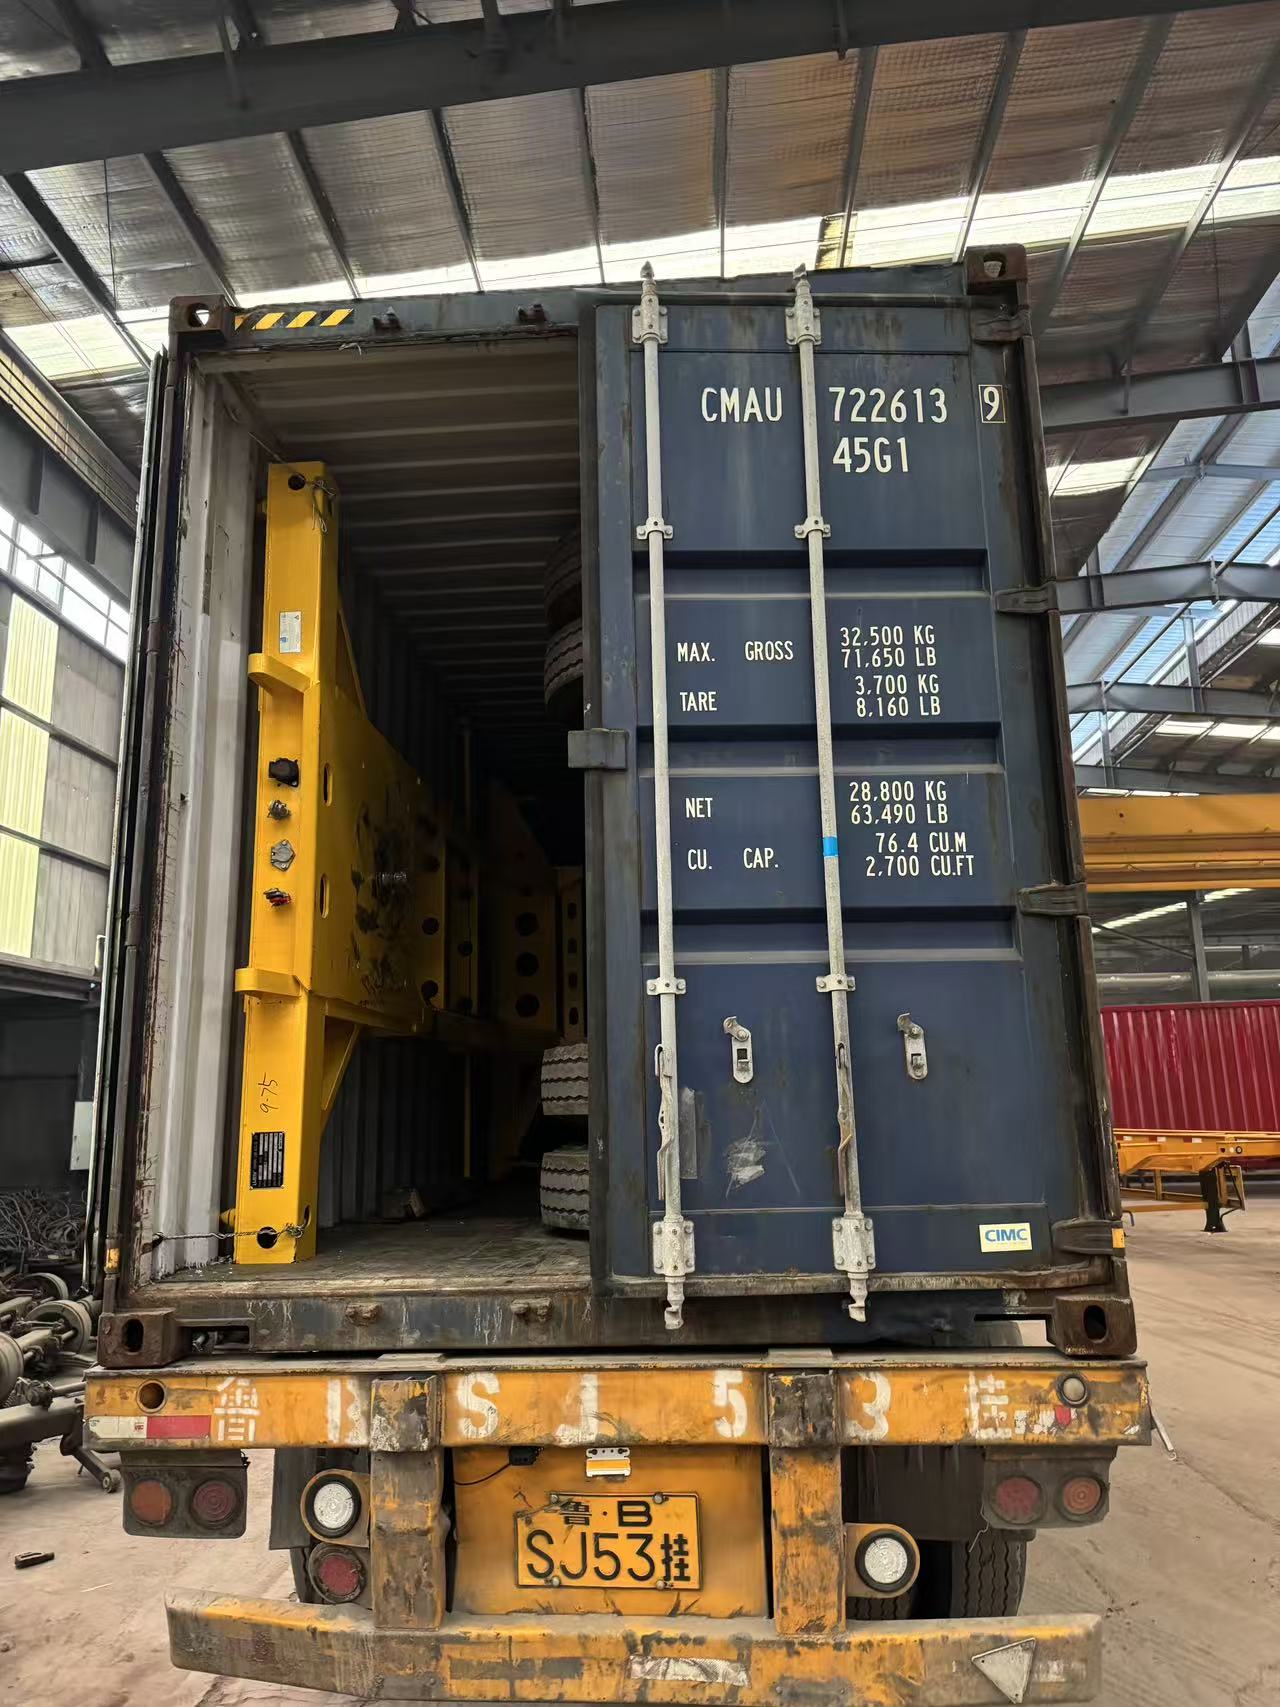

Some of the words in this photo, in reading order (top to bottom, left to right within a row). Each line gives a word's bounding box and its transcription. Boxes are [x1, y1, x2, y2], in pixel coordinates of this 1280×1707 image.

[701, 386, 783, 423] CMAU
[828, 386, 948, 424] 722613
[982, 386, 1001, 421] 9
[832, 436, 909, 473] 45G1
[839, 626, 904, 650] 32,500
[913, 624, 936, 647] KG
[677, 641, 716, 662] MAX.
[744, 640, 794, 661] GROSS
[840, 647, 905, 669] 71,650
[915, 646, 937, 667] LB
[854, 674, 908, 697] 3,700
[917, 673, 940, 695] KG
[679, 691, 718, 712] TARE
[856, 696, 909, 718] 8,160
[919, 695, 941, 716] LB
[848, 780, 915, 803] 28,800
[924, 780, 947, 802] KG
[685, 797, 714, 819] NET
[850, 803, 916, 826] 63,490
[926, 803, 948, 824] LB
[875, 832, 919, 854] 76.4
[929, 831, 967, 854] CU.M
[687, 848, 713, 871] CU.
[743, 847, 779, 869] CAP.
[865, 855, 920, 877] 2,700
[984, 1228, 1028, 1242] CIMC
